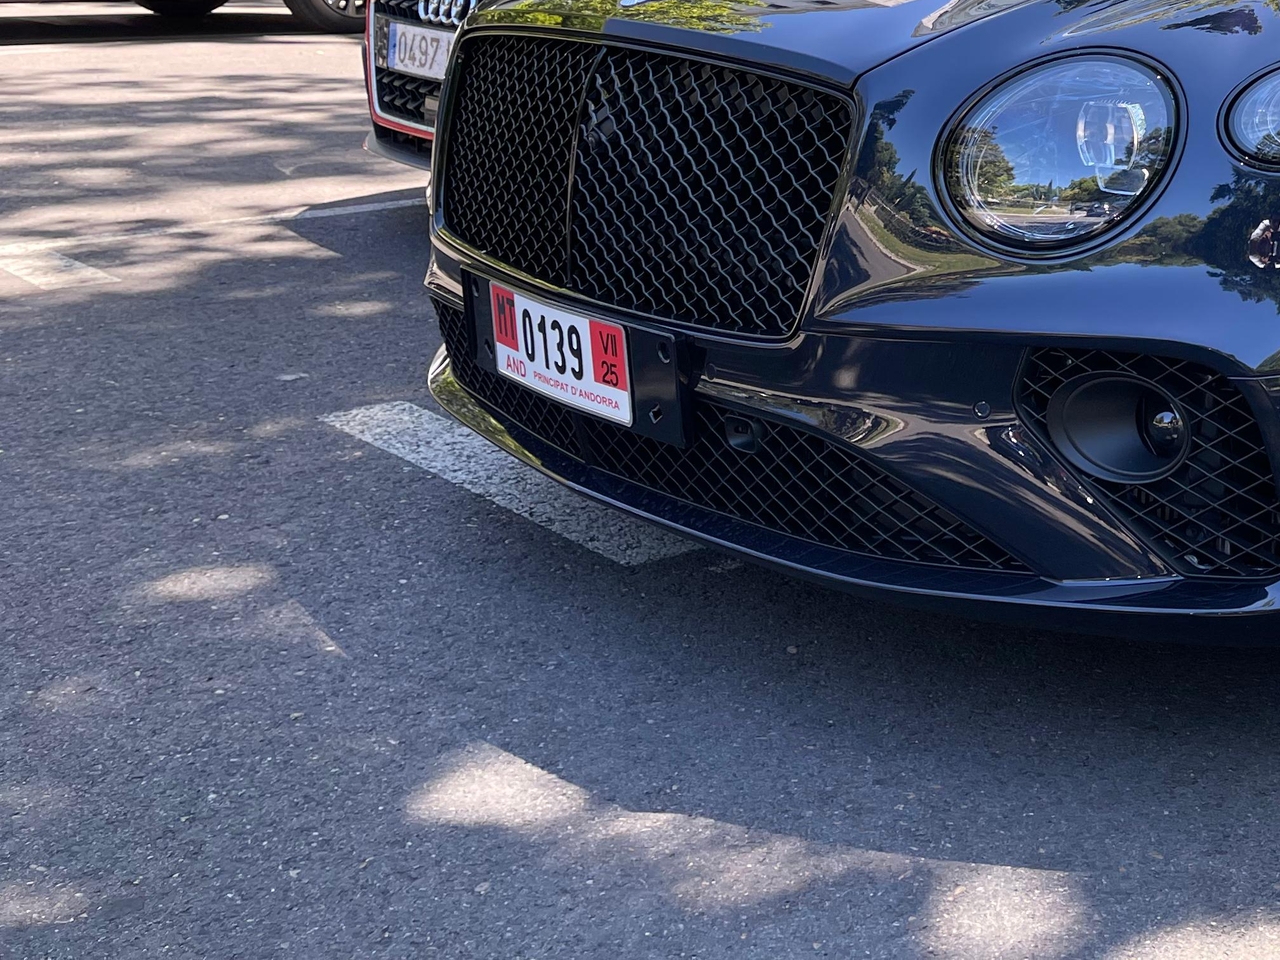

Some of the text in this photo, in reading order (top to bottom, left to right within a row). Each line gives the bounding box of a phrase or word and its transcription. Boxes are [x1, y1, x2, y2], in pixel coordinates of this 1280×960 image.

[398, 31, 440, 71] 0497
[522, 308, 584, 381] 0139
[599, 330, 618, 358] VII
[506, 354, 620, 411] AND PRINCIPAT D'ANDORRA
[601, 360, 619, 387] 25
